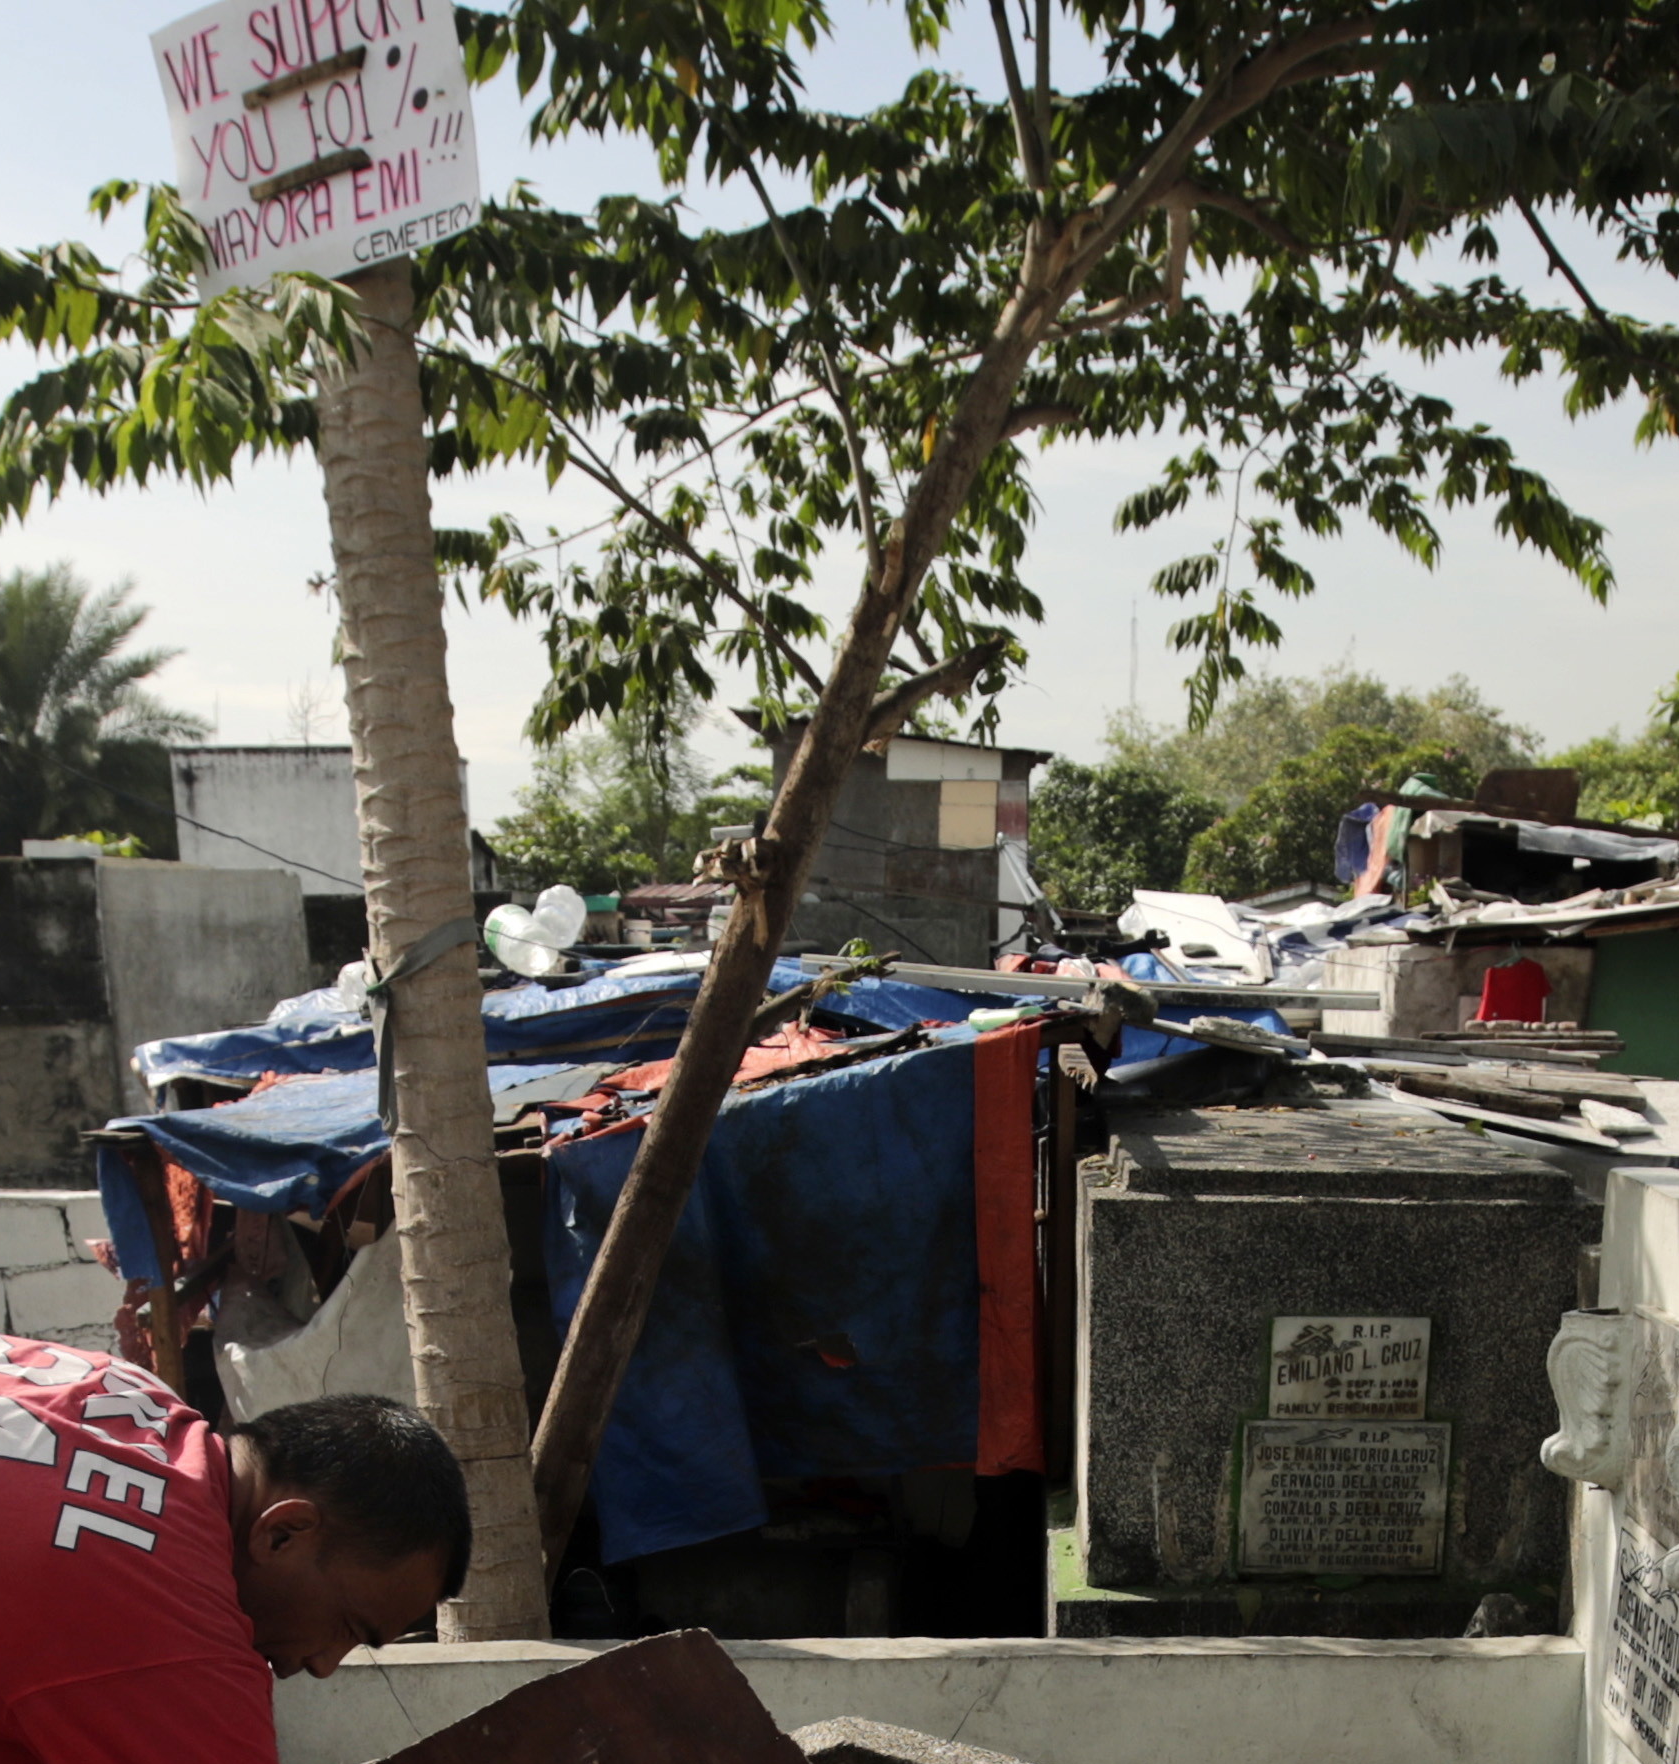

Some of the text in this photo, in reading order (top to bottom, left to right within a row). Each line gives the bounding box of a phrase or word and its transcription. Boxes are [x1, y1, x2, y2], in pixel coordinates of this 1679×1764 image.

[164, 24, 229, 113] WE
[191, 106, 276, 199] YOU
[199, 149, 422, 276] MAYORA EMI
[352, 201, 478, 263] CEMETERY
[1277, 1338, 1422, 1386] EMILIANO L. CRUZ
[1276, 1402, 1418, 1414] FAMILY REMEMBRANCE
[1256, 1446, 1291, 1461] JOSE
[1295, 1447, 1326, 1461] MARI
[1331, 1448, 1388, 1463] VICTORIO
[1271, 1474, 1420, 1490] GERVACIO DELA CRUZ
[1345, 1501, 1381, 1516] DELA
[1387, 1502, 1422, 1517] CRUZ
[1269, 1528, 1313, 1542] OLIVIA
[1335, 1529, 1371, 1542] DELA
[1378, 1529, 1414, 1543] CRUZ
[1269, 1554, 1412, 1566] FAMILY REMEMBRANCE
